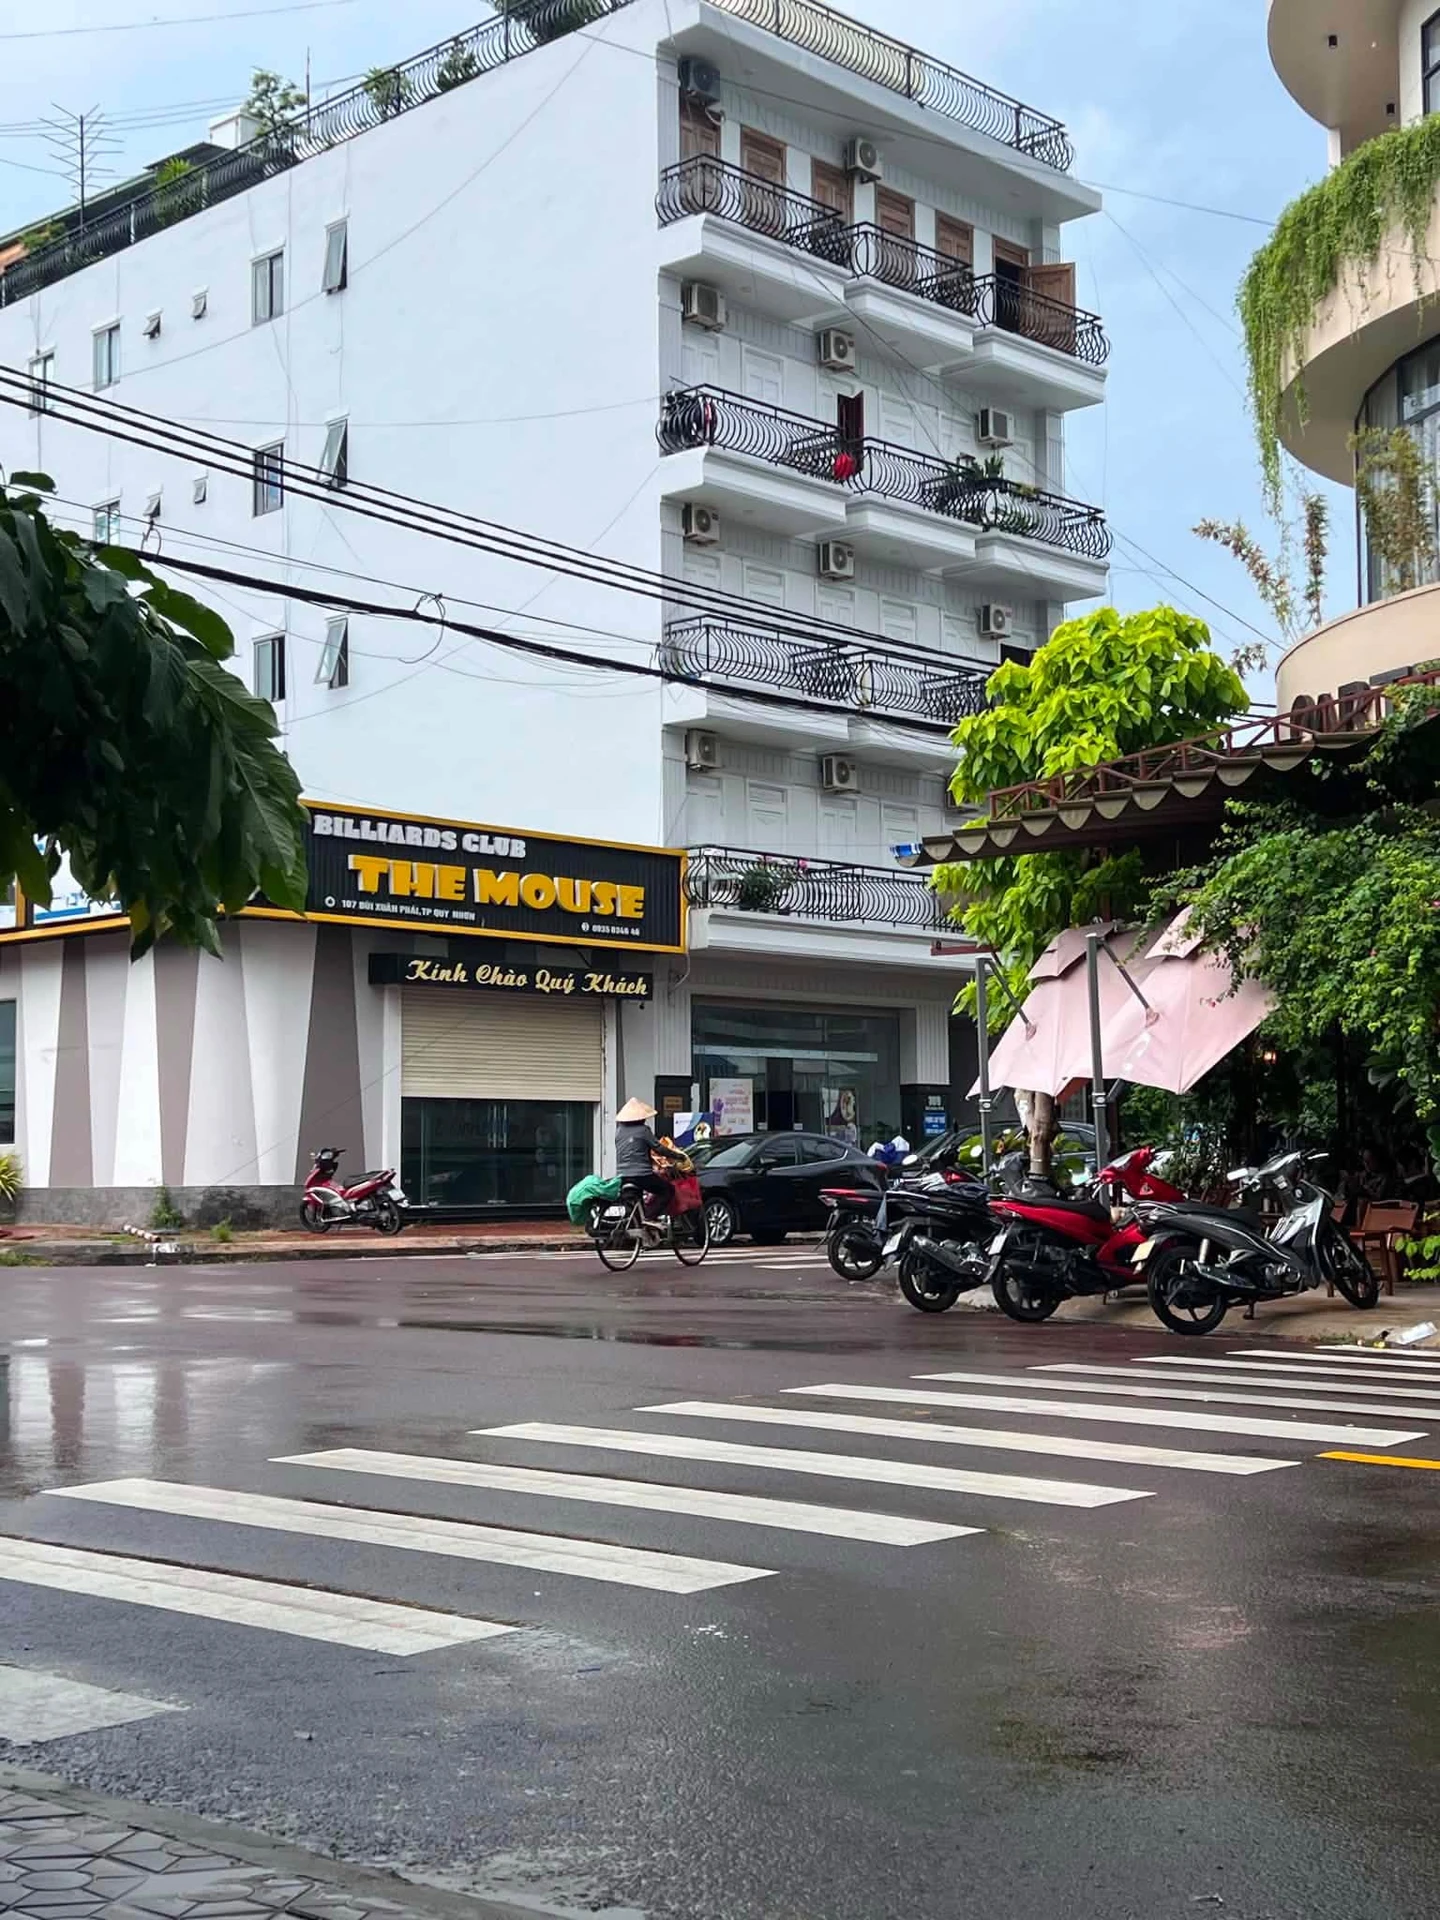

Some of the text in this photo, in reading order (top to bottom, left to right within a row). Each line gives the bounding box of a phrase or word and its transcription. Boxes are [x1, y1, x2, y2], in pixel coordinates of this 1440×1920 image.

[313, 815, 526, 858] BILLIARDS CLUB
[341, 899, 357, 909] 107
[348, 854, 645, 918] THE MOUSE
[405, 959, 648, 995] Kính Chào Quý Khách
